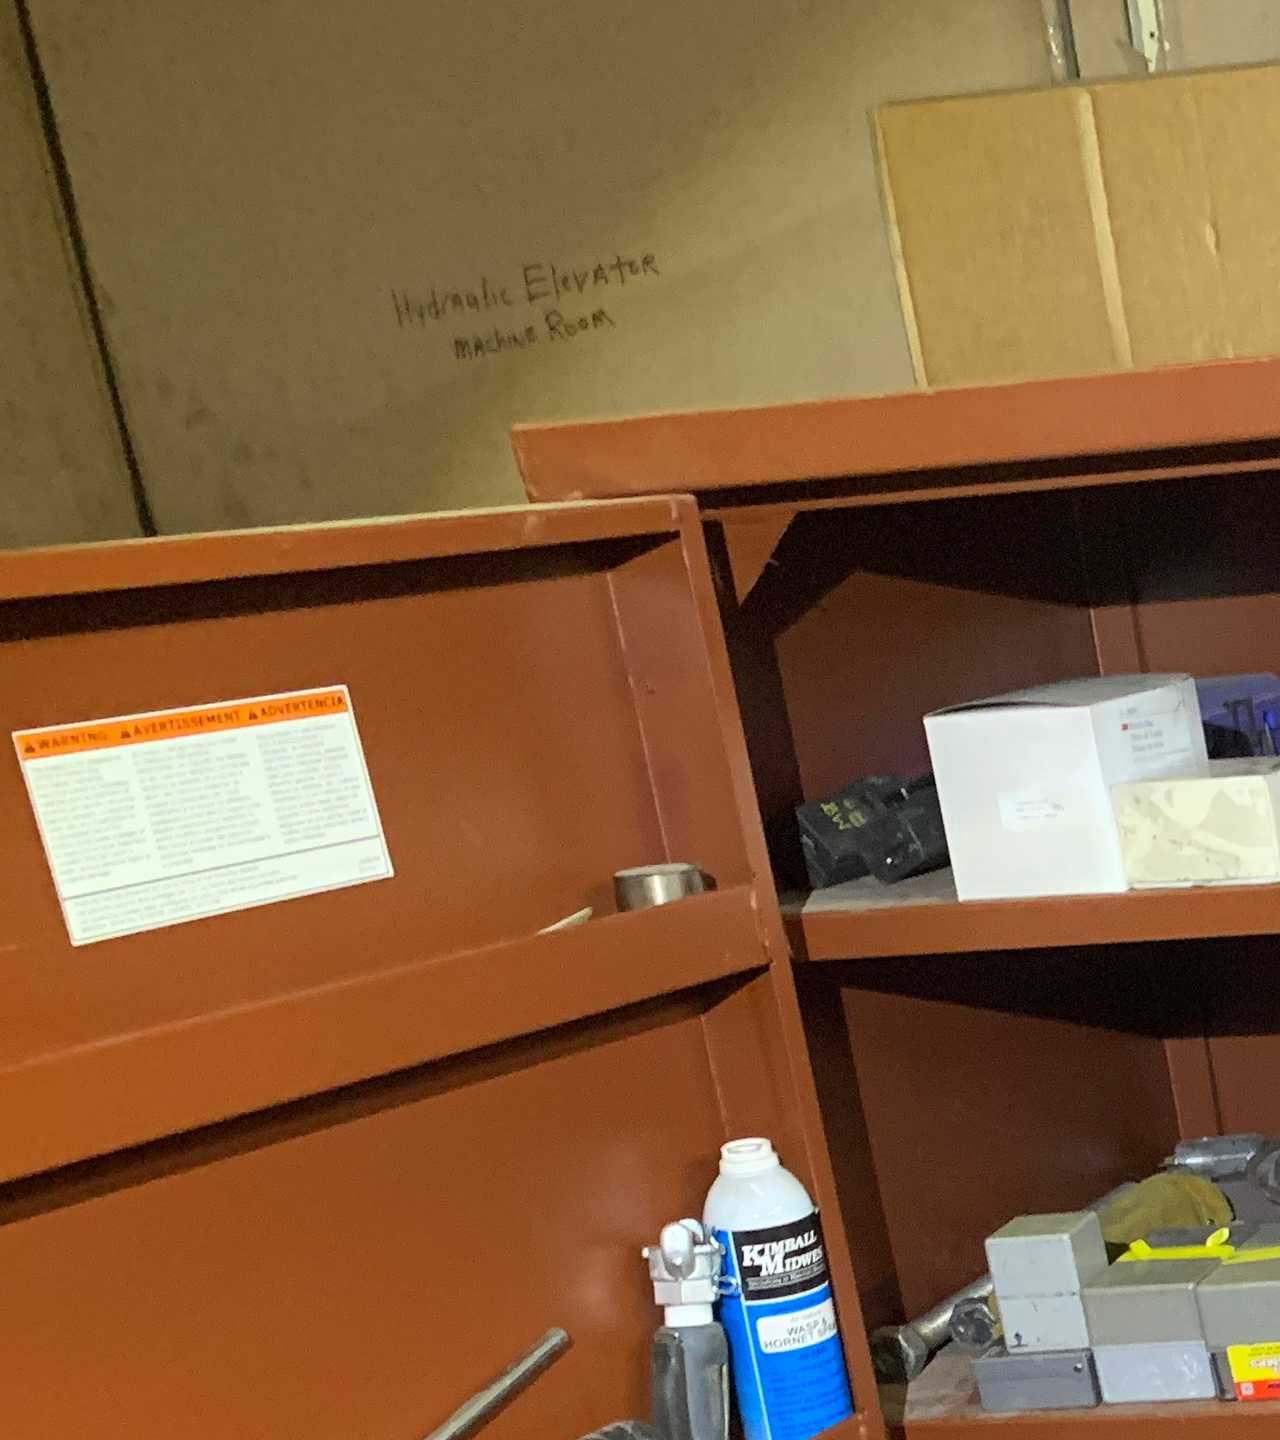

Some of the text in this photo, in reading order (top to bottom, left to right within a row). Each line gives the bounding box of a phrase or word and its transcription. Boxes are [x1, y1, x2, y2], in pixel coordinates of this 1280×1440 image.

[391, 276, 513, 329] Hydraulic
[38, 695, 346, 752] WARNING AVERTISSEMENT ADVERTENCIA
[741, 1230, 818, 1267] KIMBALL
[763, 1332, 815, 1350] HORNET
[787, 1320, 820, 1337] WASP
